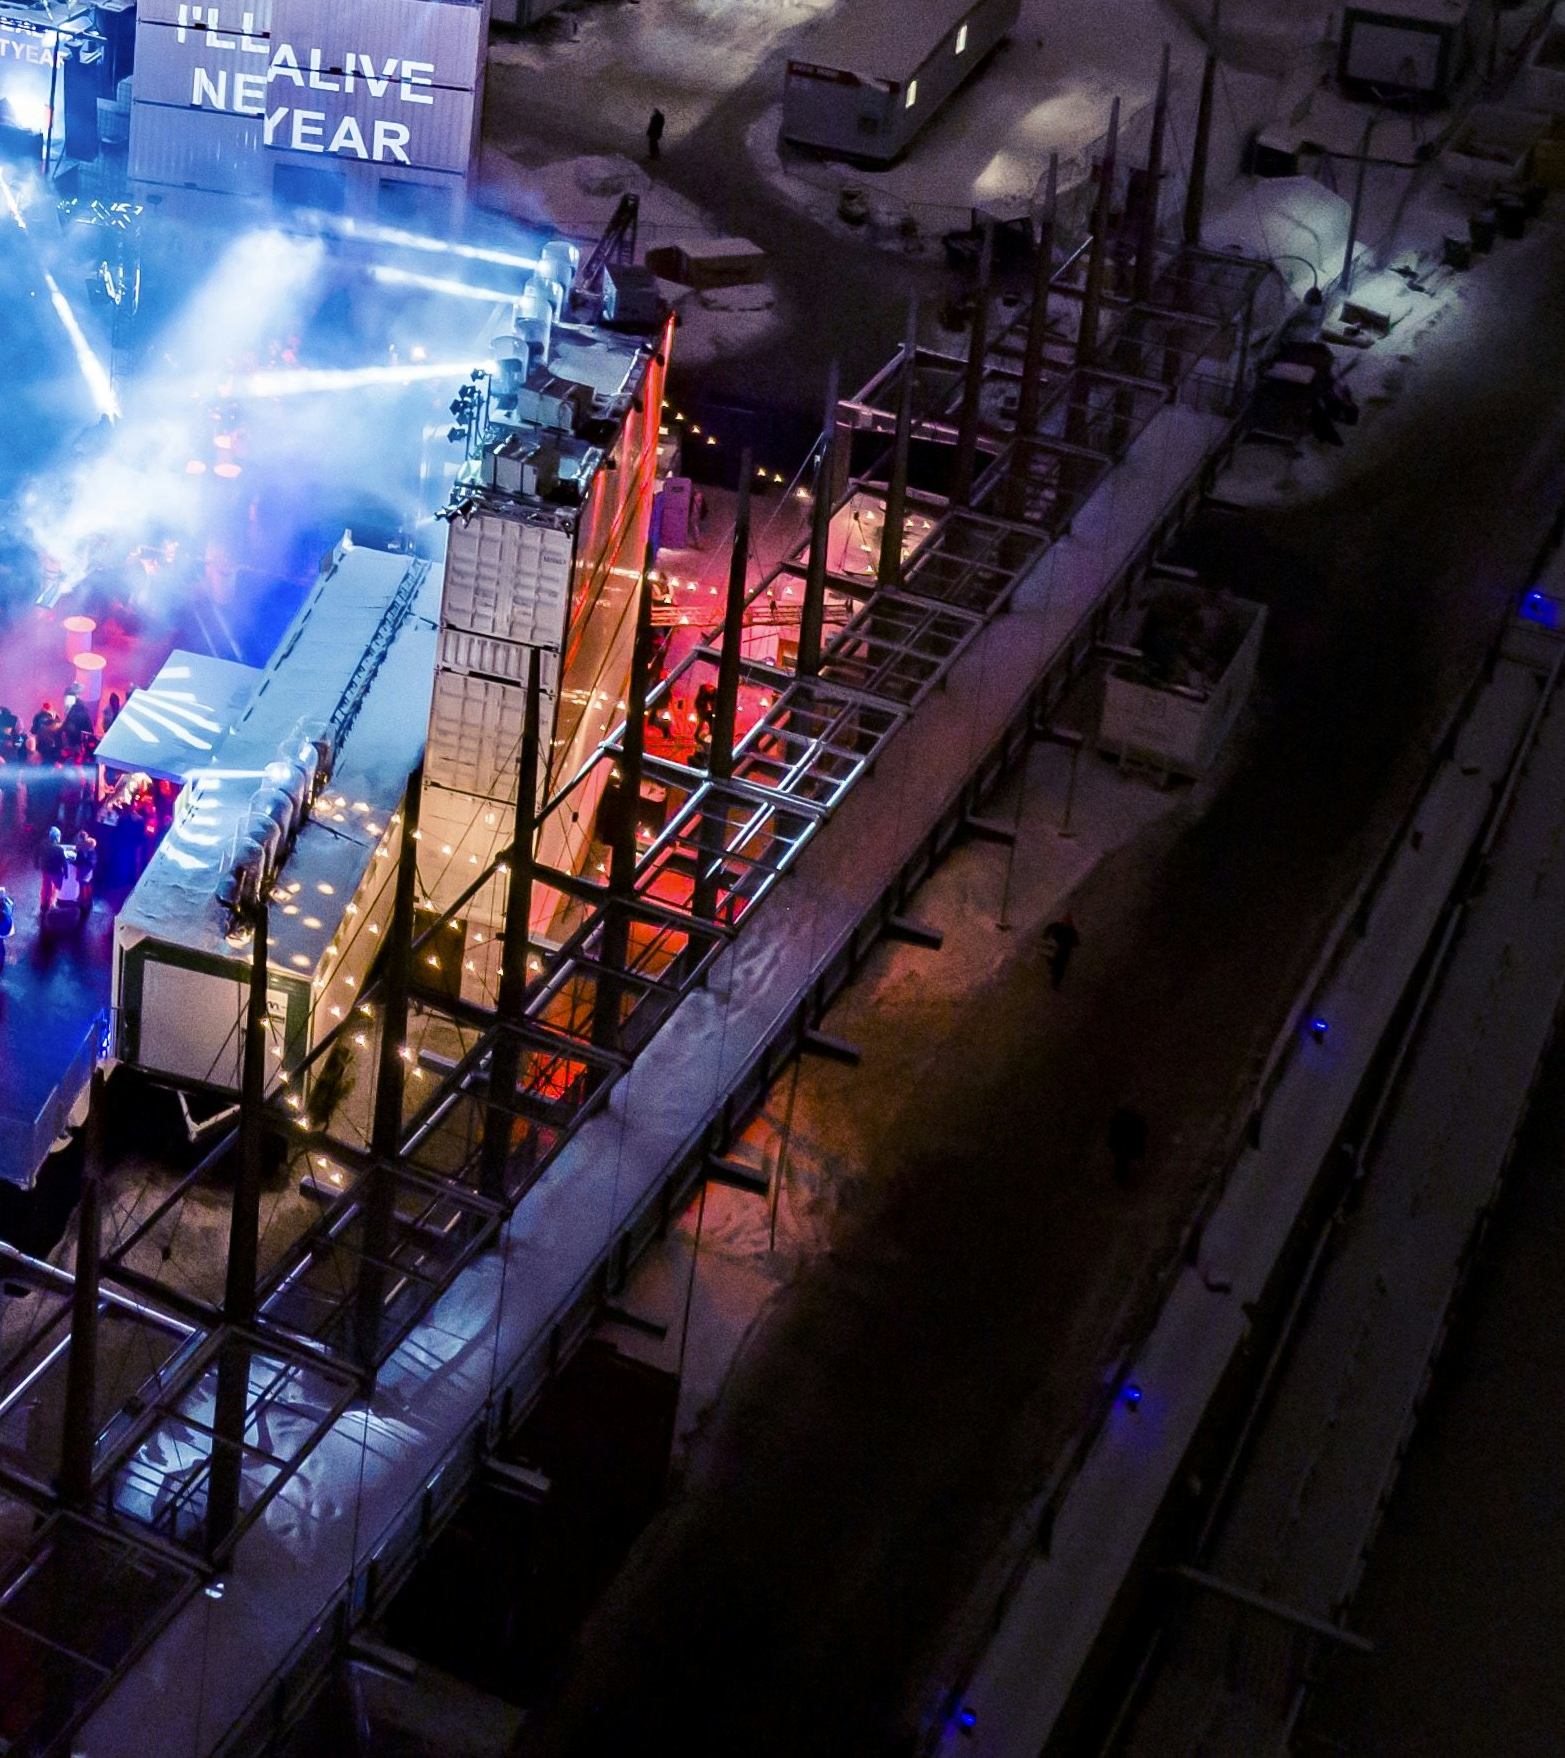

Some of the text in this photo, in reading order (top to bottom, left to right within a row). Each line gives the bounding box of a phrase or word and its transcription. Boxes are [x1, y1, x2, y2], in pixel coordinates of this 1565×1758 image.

[177, 4, 270, 54] I'LL
[193, 67, 267, 115] NE
[267, 43, 434, 104] ALIVE
[264, 107, 411, 165] YEAR
